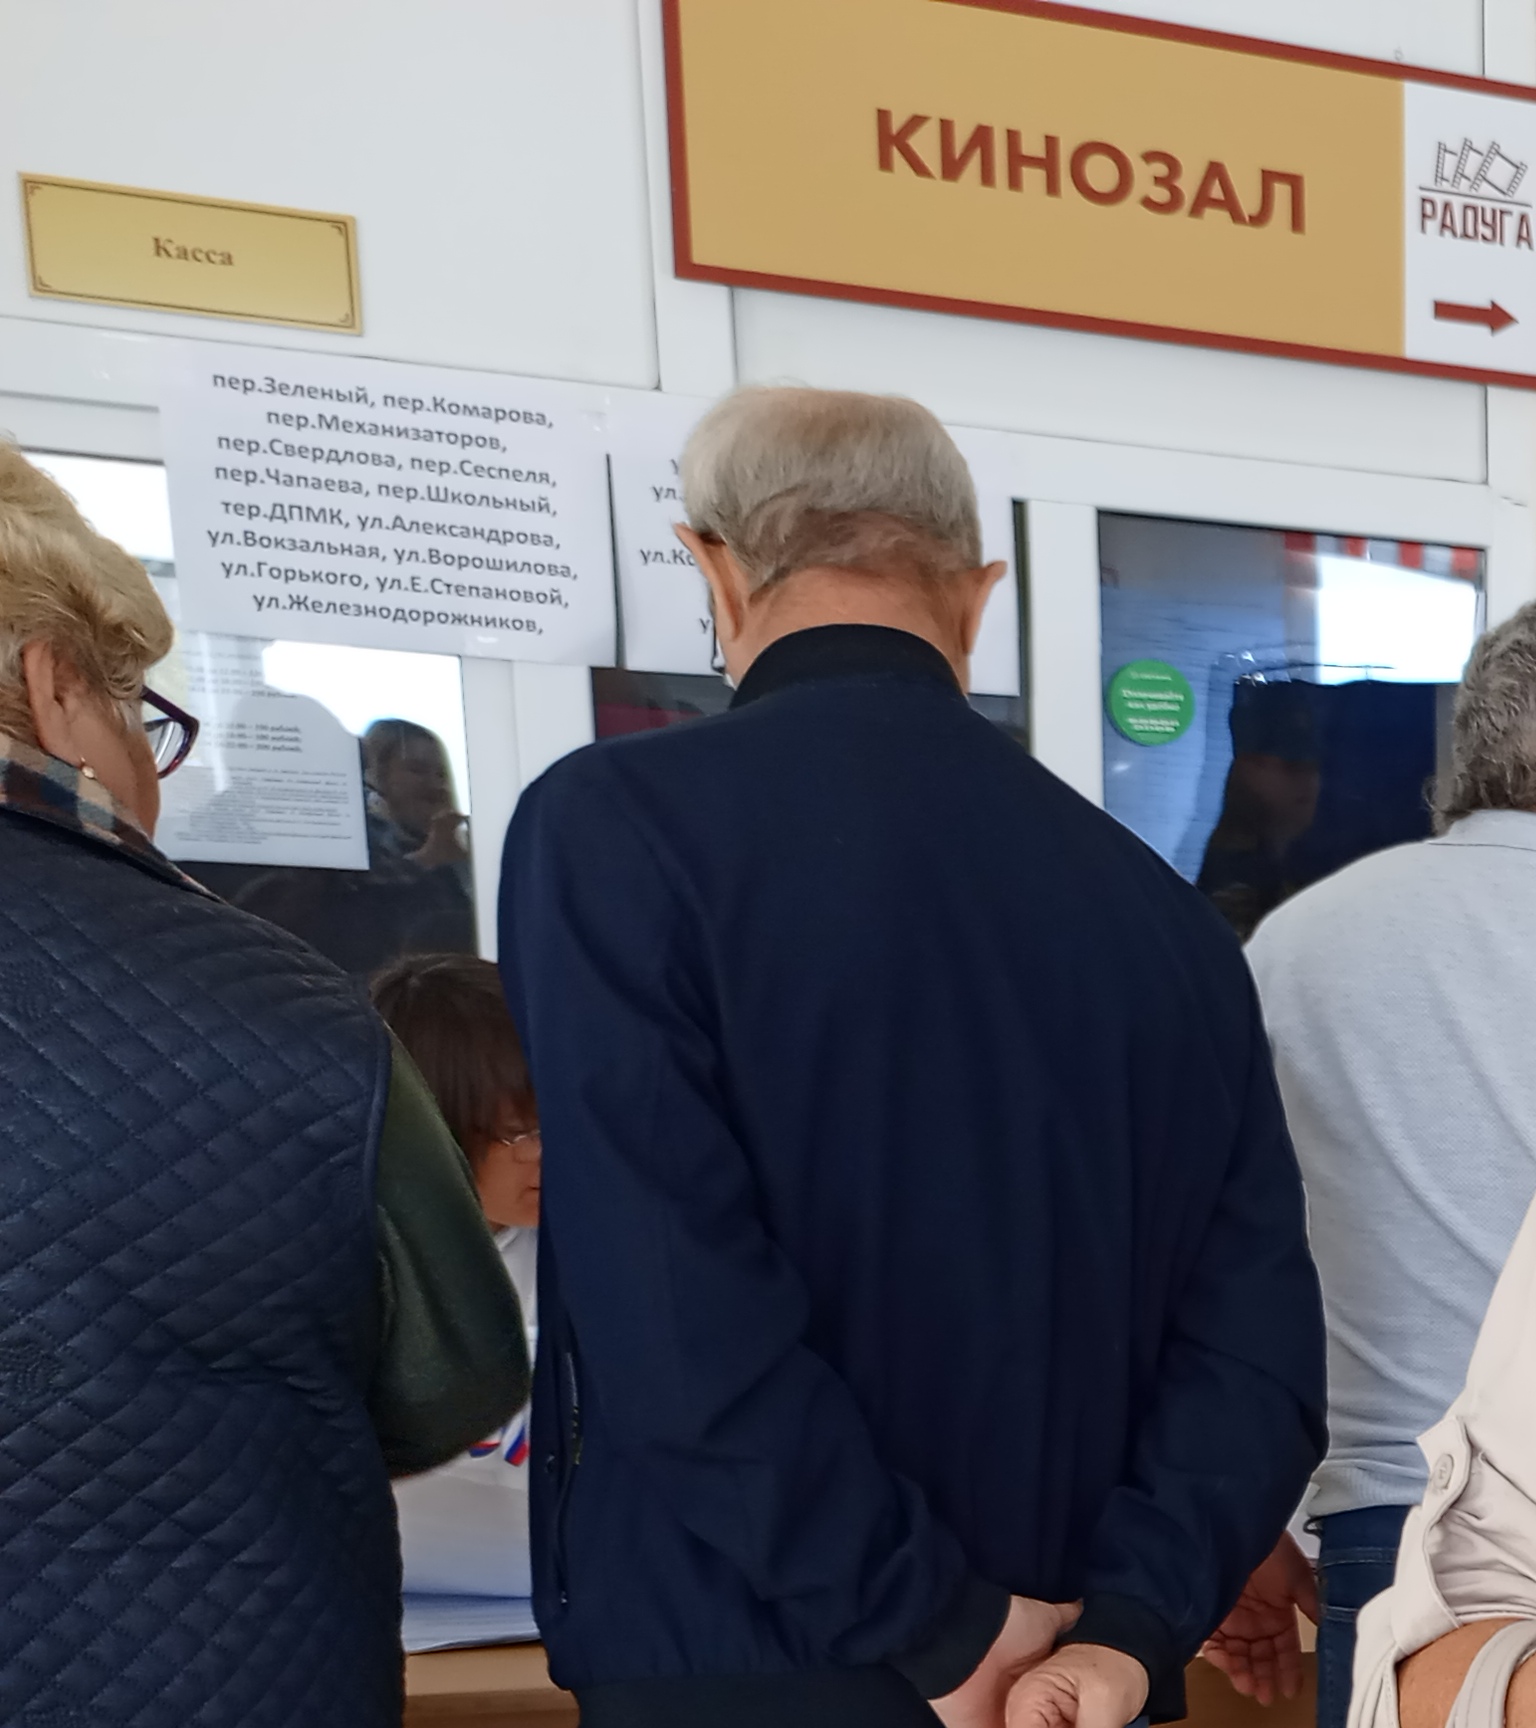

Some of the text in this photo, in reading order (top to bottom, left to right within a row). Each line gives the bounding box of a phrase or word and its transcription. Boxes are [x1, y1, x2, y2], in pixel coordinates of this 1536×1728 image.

[876, 107, 1307, 236] КИНОЗАЛ
[1419, 196, 1534, 252] РАДУГА
[152, 236, 234, 267] Касса
[212, 373, 554, 429] пер.Зеленый, пер.Комарова,
[266, 410, 507, 453] пер.Механизаторов,
[217, 435, 557, 488] пер.Свердлова, пер.Сеспеля,
[214, 465, 558, 517] пер.Чапаева, пер.Школьный,
[221, 500, 561, 550] тер.ДПМК, ул.Александрова,
[207, 529, 578, 581] ул.Вокзальная, ул.Ворошилова,
[220, 560, 569, 609] ул.Горького, ул.Е.Степановой,
[252, 594, 544, 636] ул.Железнодорожников,
